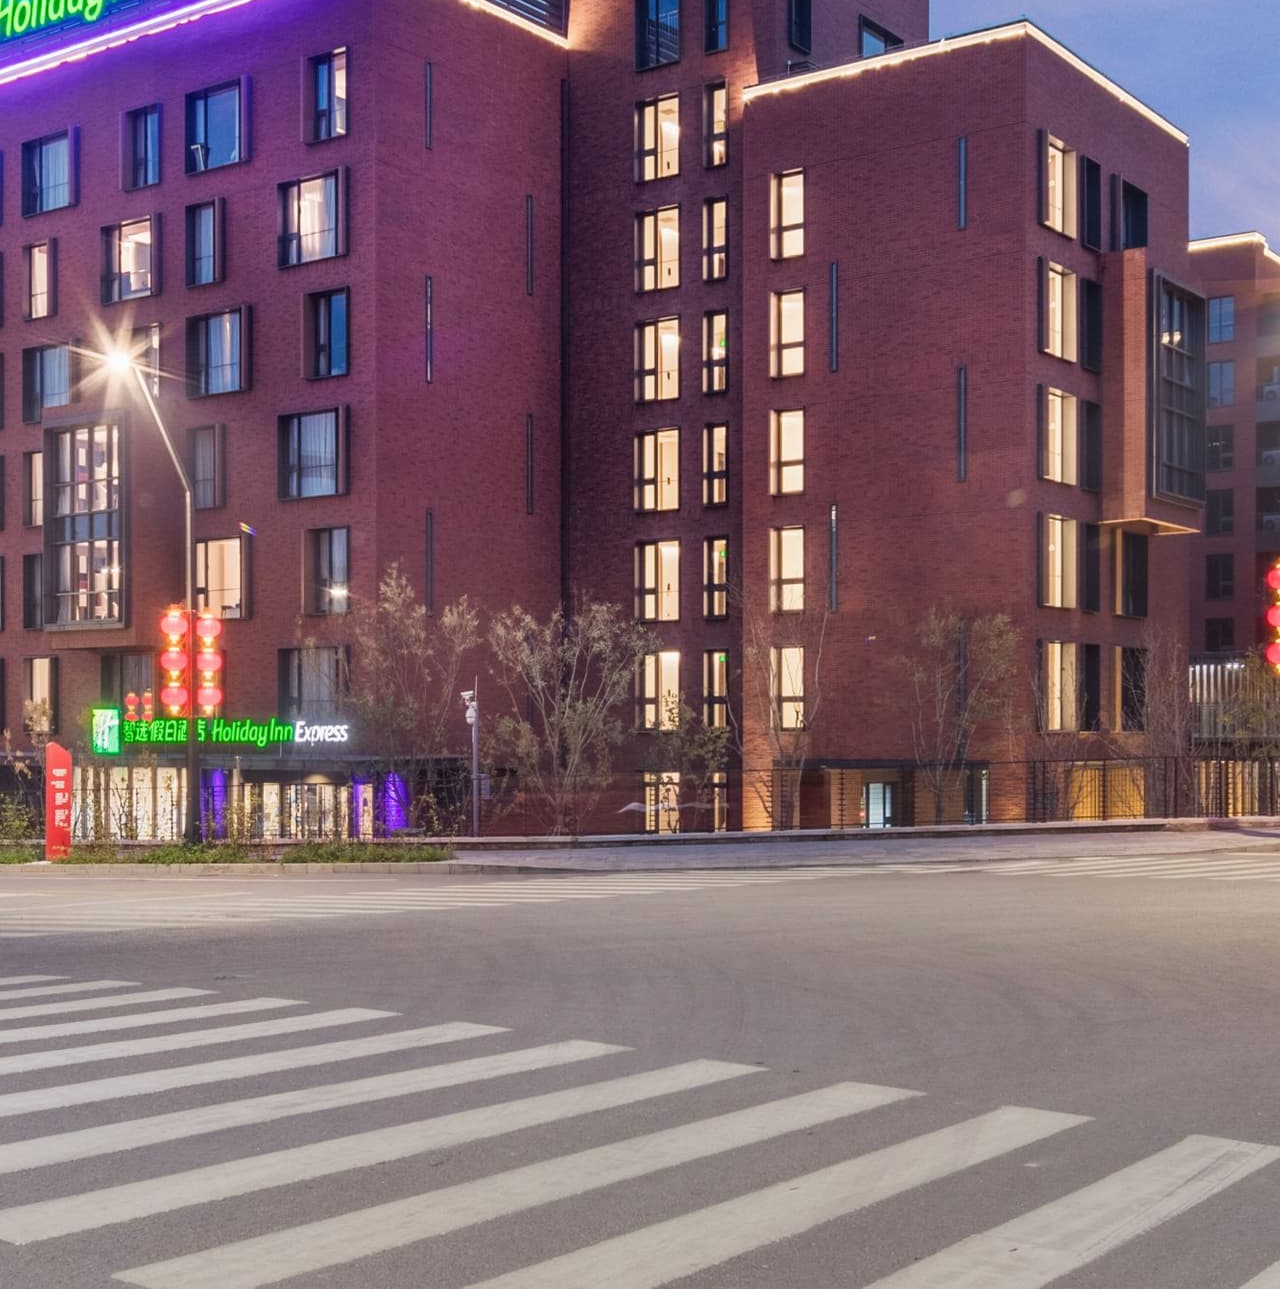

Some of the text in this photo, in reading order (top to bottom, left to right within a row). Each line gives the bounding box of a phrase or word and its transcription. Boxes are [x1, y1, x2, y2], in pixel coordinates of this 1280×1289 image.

[212, 718, 349, 747] Holiday Inn Express
